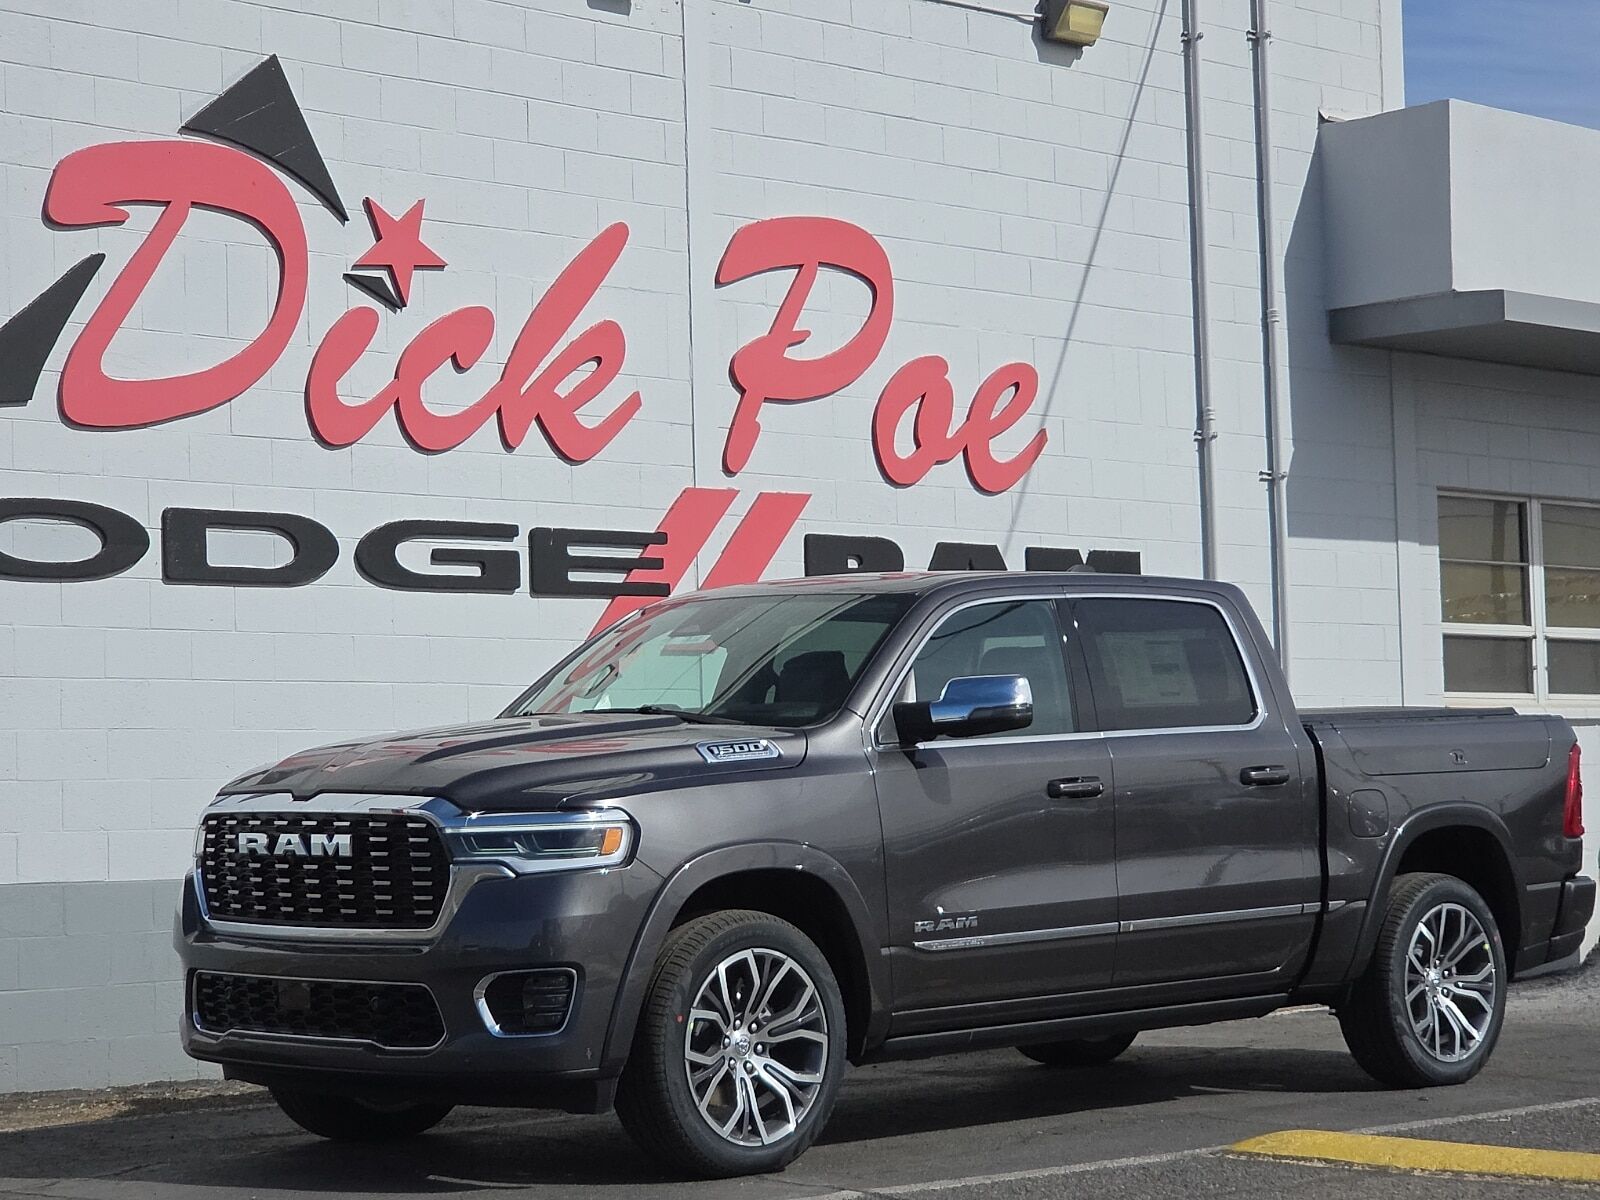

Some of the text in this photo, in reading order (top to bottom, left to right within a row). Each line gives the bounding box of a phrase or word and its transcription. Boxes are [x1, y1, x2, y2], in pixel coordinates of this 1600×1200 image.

[42, 138, 1048, 496] Dick Poe
[708, 742, 765, 756] 1500
[238, 832, 353, 857] RAM
[914, 915, 978, 933] RAM
